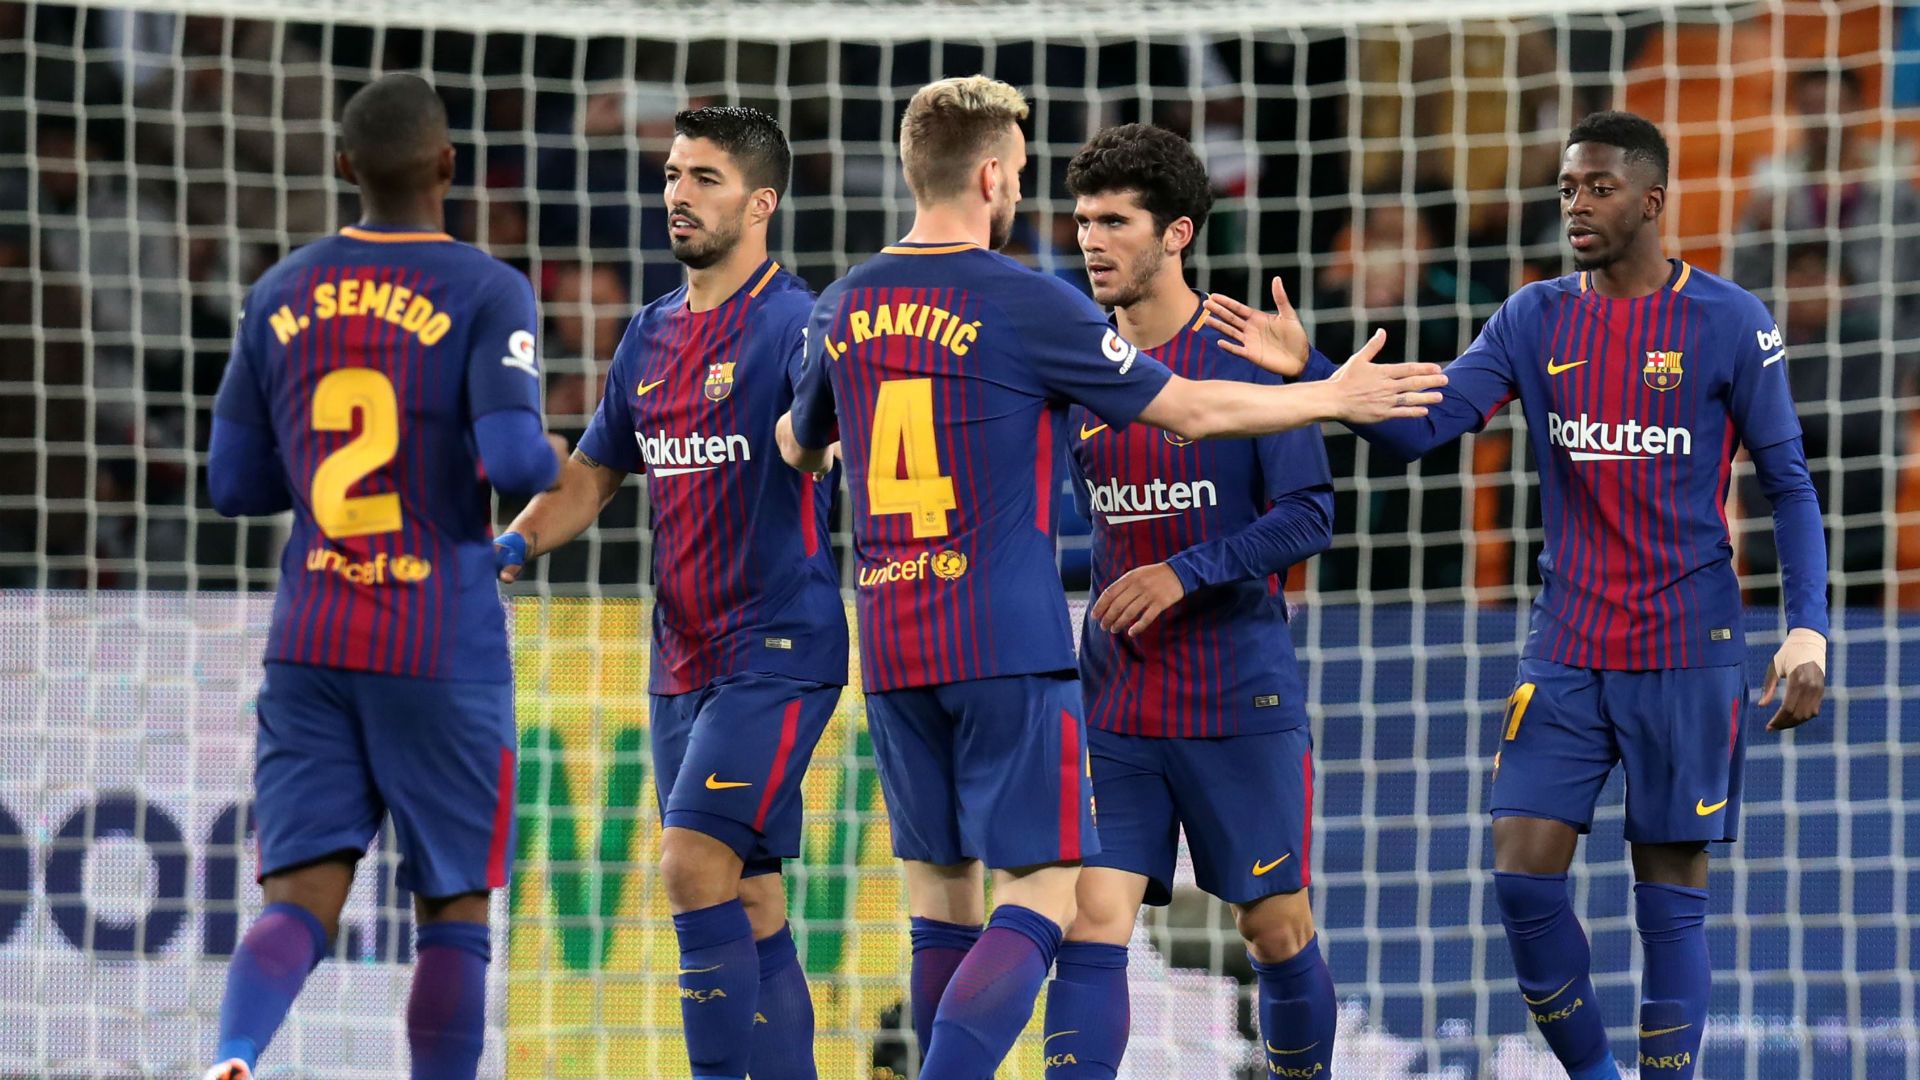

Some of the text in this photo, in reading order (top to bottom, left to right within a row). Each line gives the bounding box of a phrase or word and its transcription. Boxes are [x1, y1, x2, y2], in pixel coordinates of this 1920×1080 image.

[269, 279, 451, 346] N. SEMEDO
[850, 303, 982, 356] RAKITIĆ
[312, 367, 403, 539] 2
[634, 429, 751, 465] Rakuten
[1547, 411, 1691, 455] Rakuten
[867, 378, 957, 538] 4
[1085, 477, 1217, 512] Rakuten
[859, 552, 929, 586] unicef
